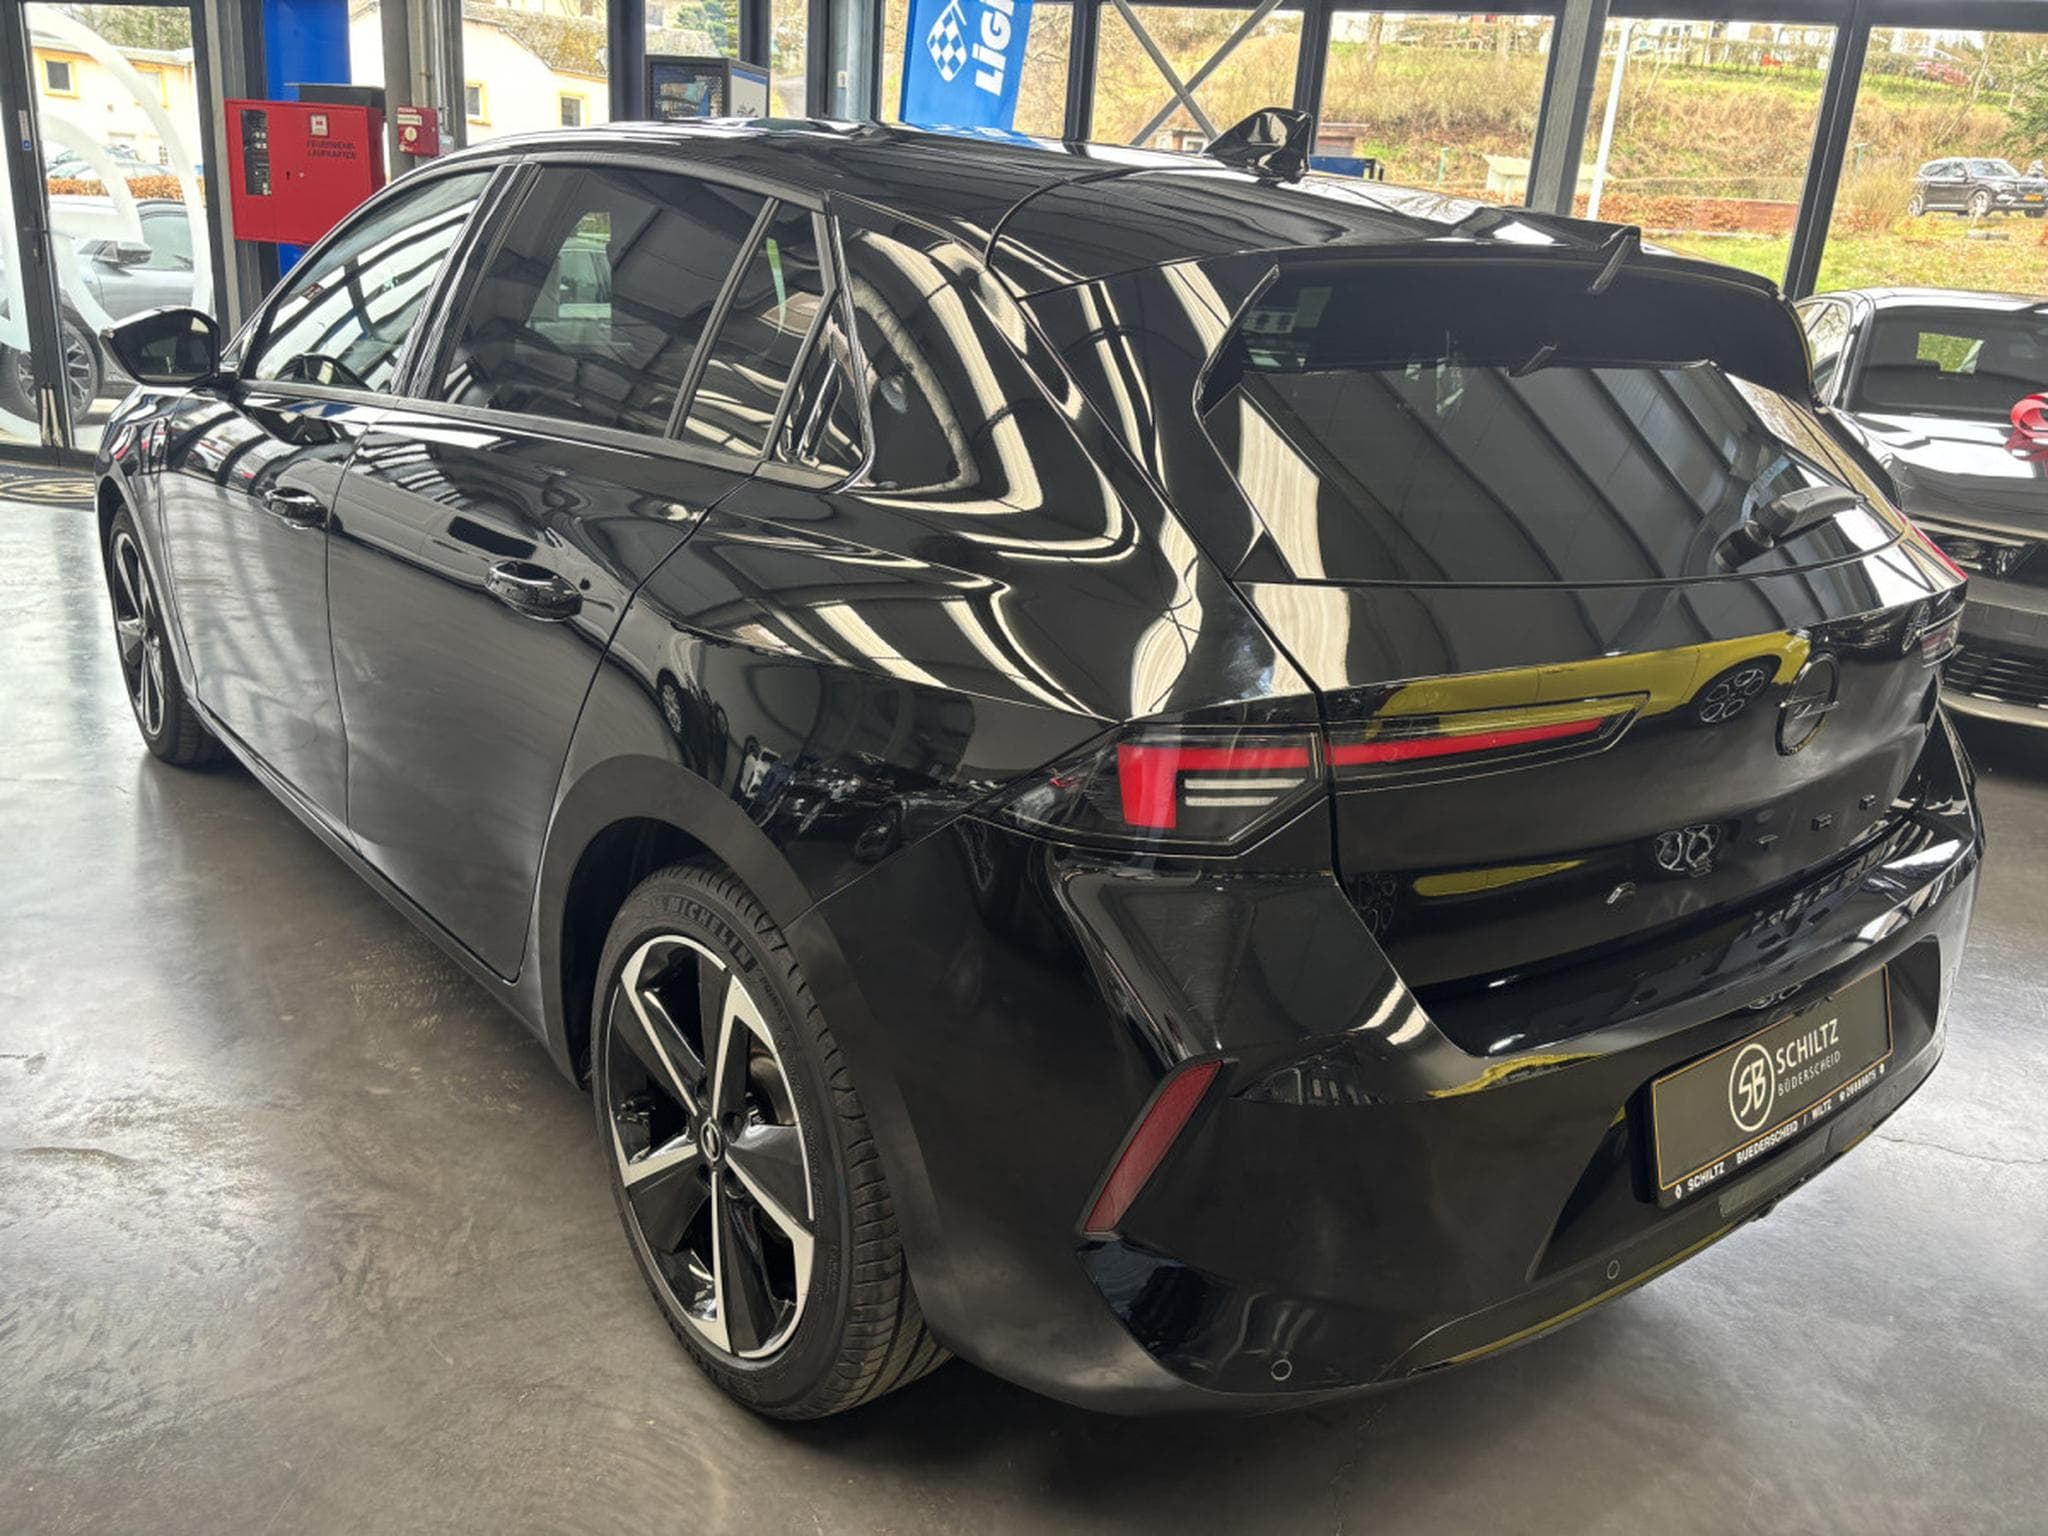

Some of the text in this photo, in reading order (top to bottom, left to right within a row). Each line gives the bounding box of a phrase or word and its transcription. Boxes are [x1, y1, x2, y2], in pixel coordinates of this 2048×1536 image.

[668, 896, 758, 972] MICHELIN
[1776, 1018, 1839, 1074] SCHILTZ
[1778, 1050, 1841, 1096] BÜDERSCHEID
[1687, 1162, 1725, 1192] SCHILTZ
[1736, 1121, 1799, 1165] BUEDERSCHEID
[1812, 1099, 1833, 1120] WILTZ
